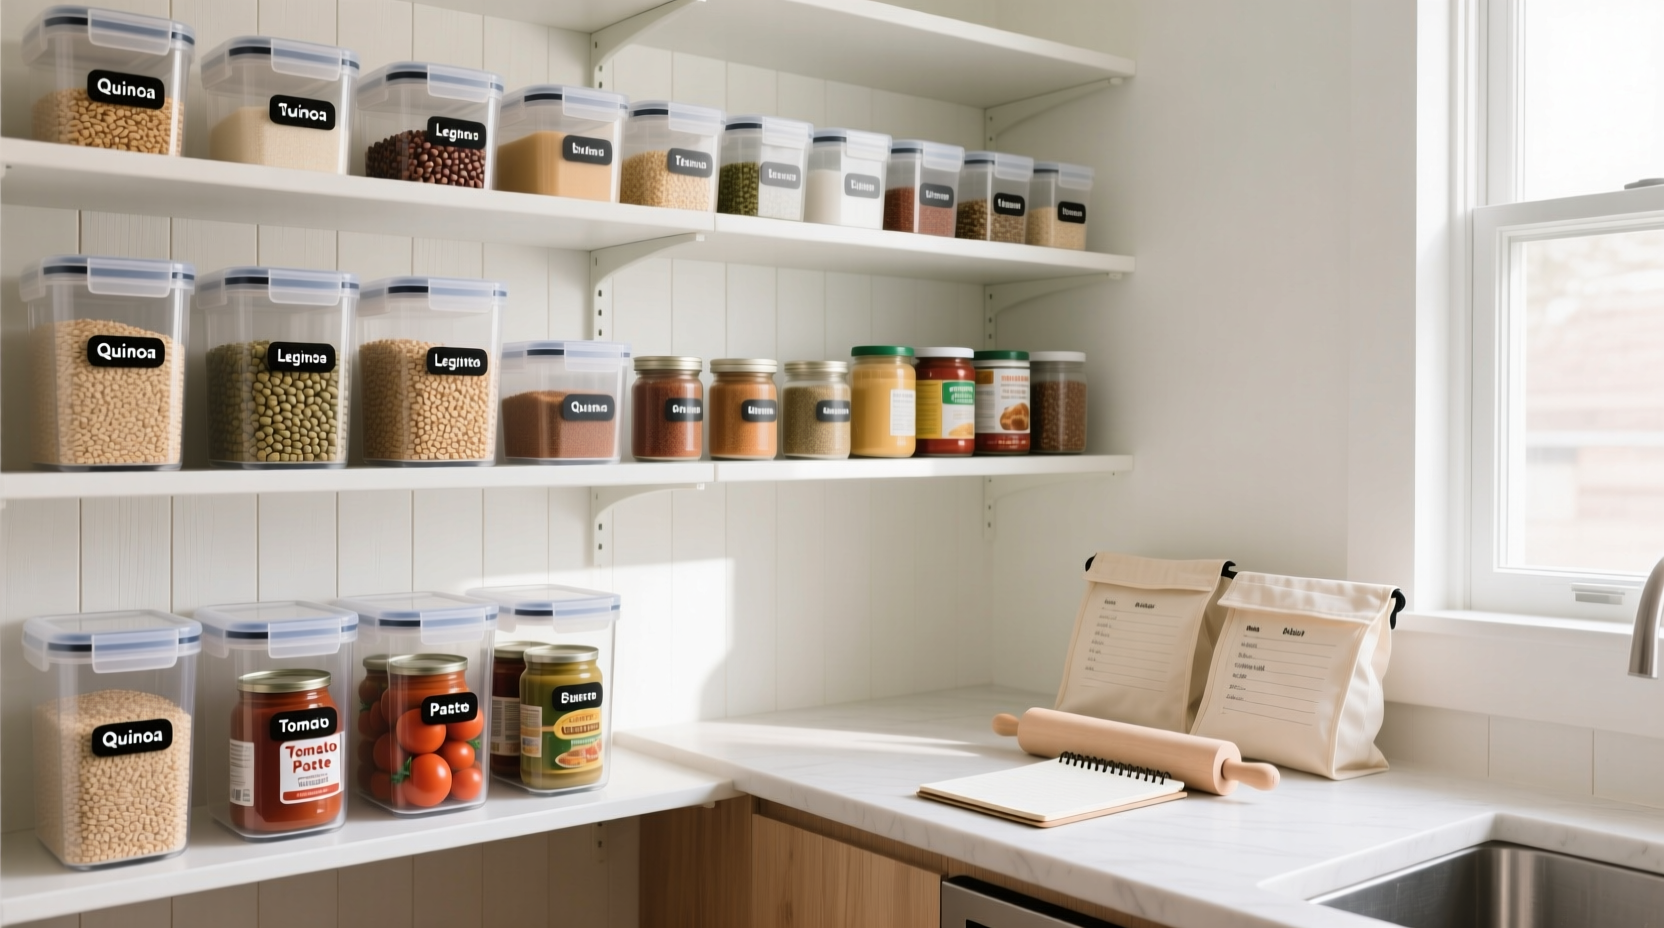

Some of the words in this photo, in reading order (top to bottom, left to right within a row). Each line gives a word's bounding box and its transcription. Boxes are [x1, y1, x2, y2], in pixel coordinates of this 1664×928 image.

[97, 78, 155, 99] Quinoa
[97, 342, 156, 360] Quinoa
[102, 729, 163, 748] Quinoa
